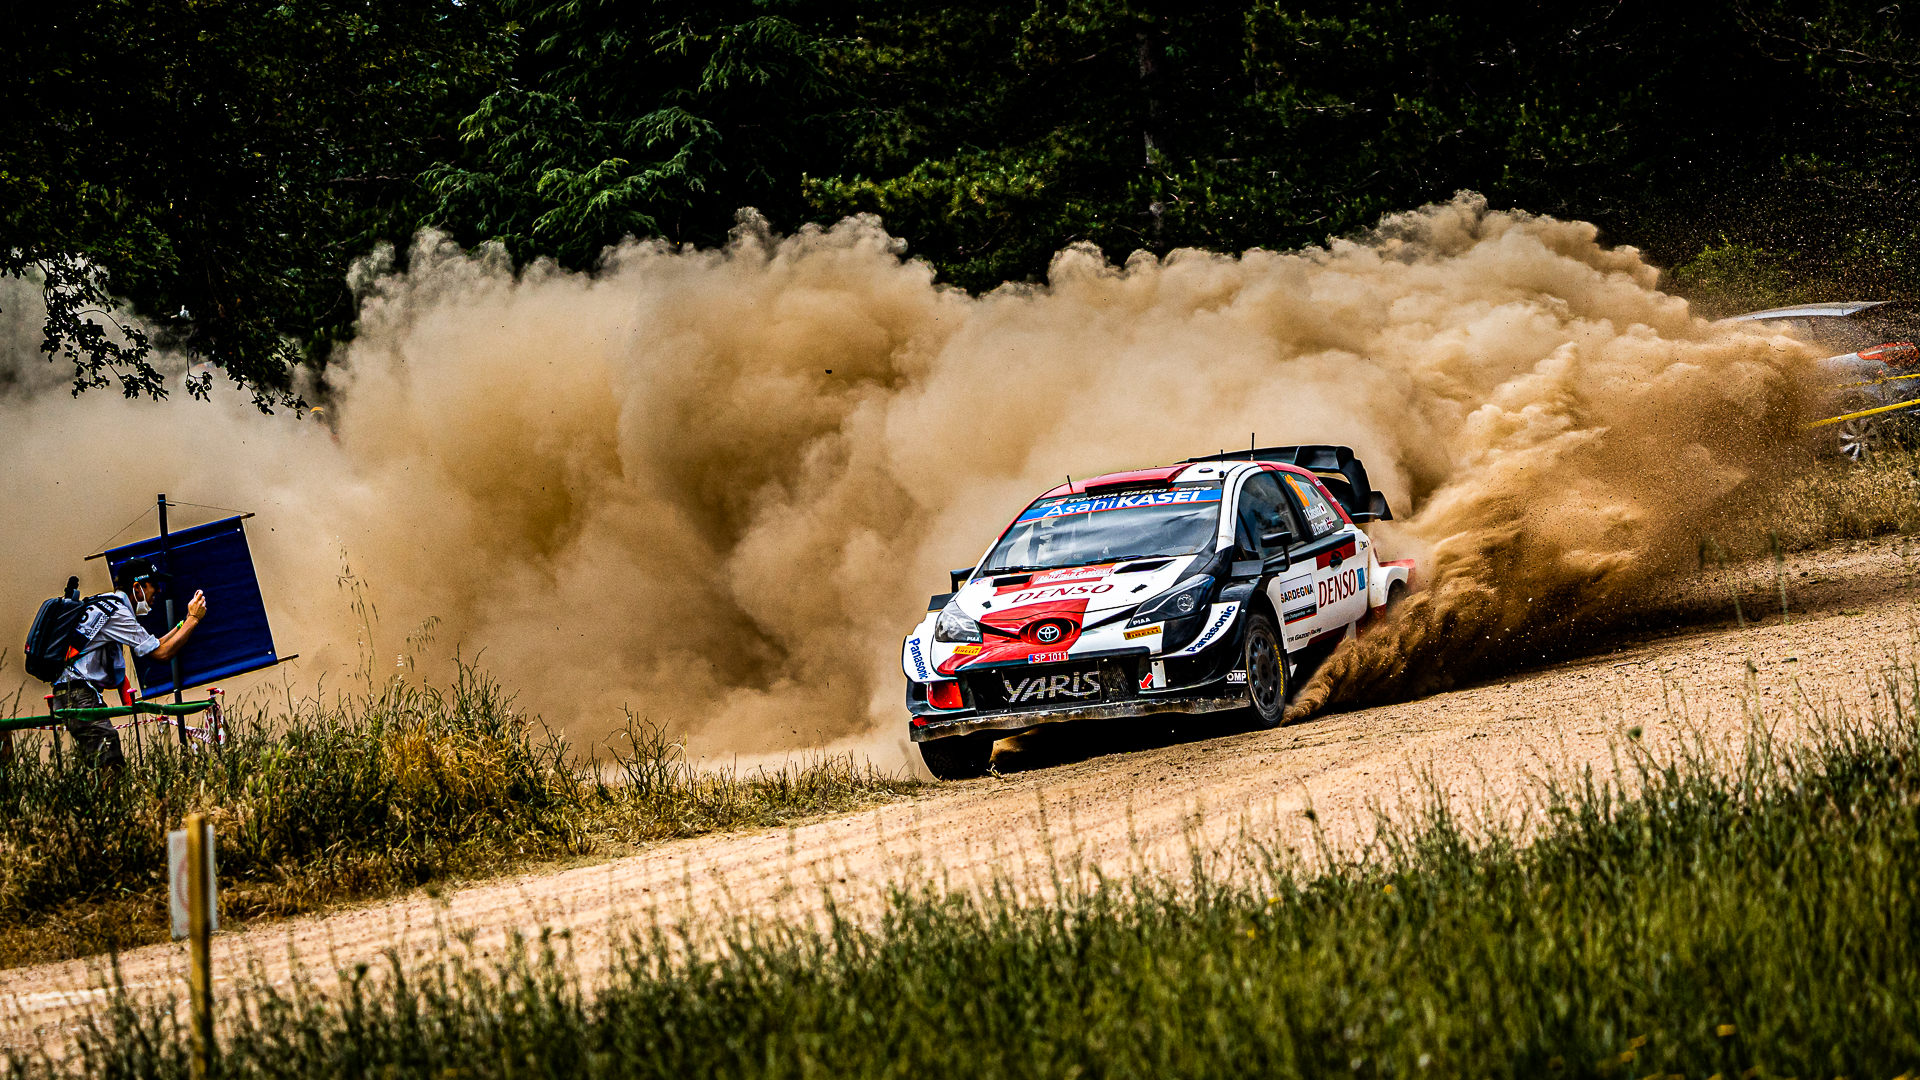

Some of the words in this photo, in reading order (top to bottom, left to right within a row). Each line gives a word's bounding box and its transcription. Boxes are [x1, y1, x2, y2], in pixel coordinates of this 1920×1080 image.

[1043, 498, 1117, 517] Asahi
[1115, 491, 1200, 507] KASEI
[1012, 583, 1115, 604] DENSO
[1280, 583, 1314, 604] SARDEGNA
[1318, 568, 1357, 609] DENSO
[1132, 617, 1151, 626] PIAA
[1186, 605, 1236, 653] Panasonic
[1126, 626, 1160, 639] PIRELLI
[909, 637, 931, 680] Panasonic
[954, 646, 980, 654] PIRELLI
[1035, 653, 1046, 662] SP
[1048, 651, 1068, 661] 1011
[1227, 672, 1246, 682] OMP
